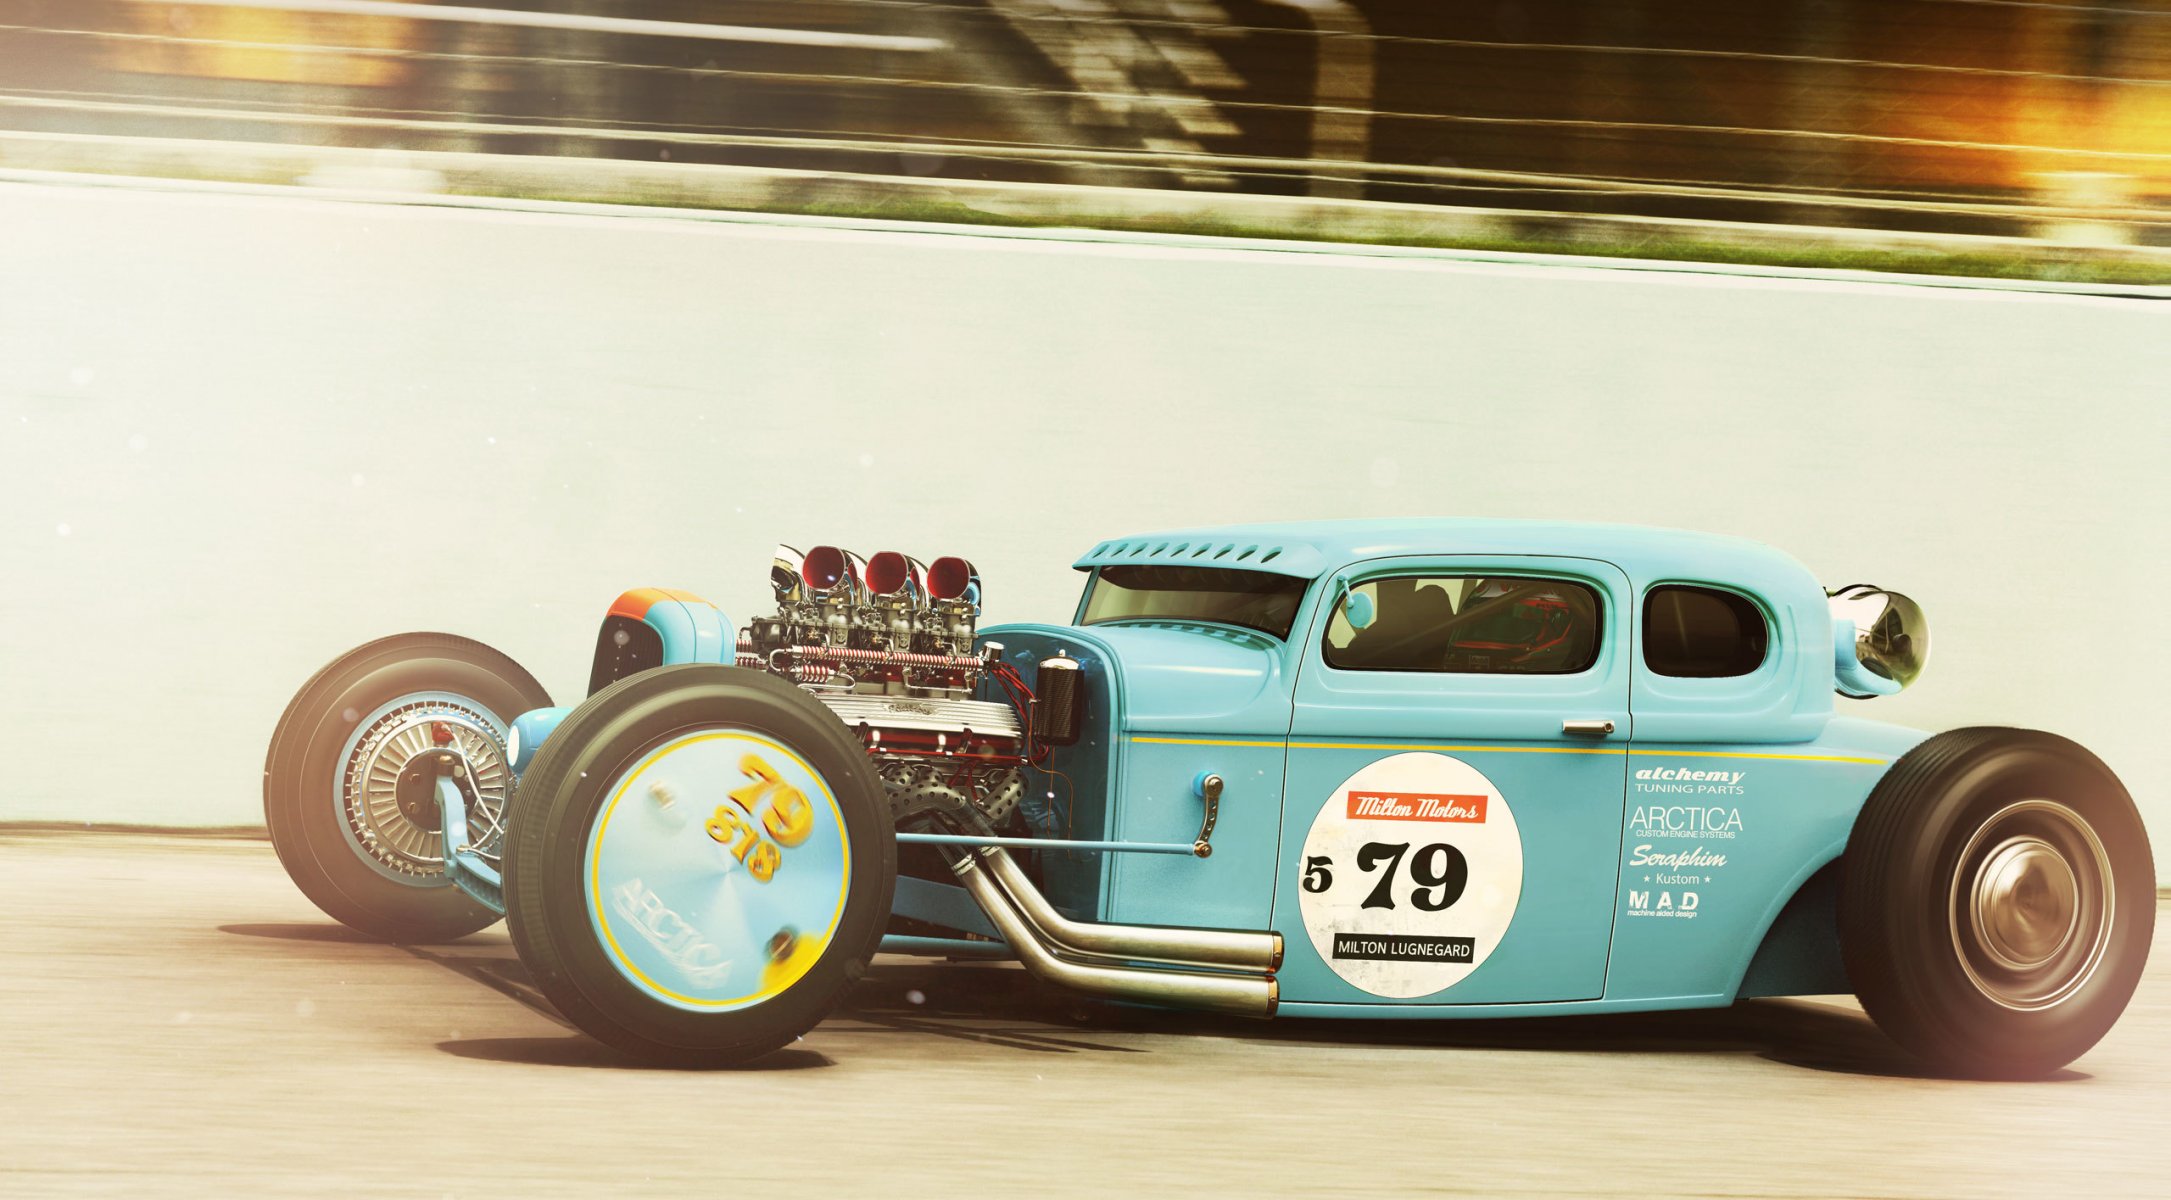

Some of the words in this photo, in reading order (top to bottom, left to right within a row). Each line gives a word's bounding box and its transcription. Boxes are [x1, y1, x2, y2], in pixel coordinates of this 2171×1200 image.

[1635, 767, 1746, 785] alchemy
[1635, 784, 1693, 794] TUNING
[1698, 785, 1745, 795] PARTS
[727, 754, 814, 848] 79
[1356, 797, 1414, 817] Milton
[1416, 798, 1478, 819] Motors
[1629, 806, 1743, 831] ARCTICA
[1636, 829, 1669, 838] CUSTOM
[1670, 830, 1699, 838] ENGINE
[1700, 831, 1736, 839] SYSTEMS
[1629, 844, 1728, 871] Seraphim
[1303, 855, 1334, 893] 5
[1356, 841, 1469, 912] 79
[1656, 873, 1700, 884] Kustom
[1675, 910, 1698, 919] design
[1338, 940, 1387, 955] MILTON
[1391, 941, 1470, 957] LUGNEGARD
